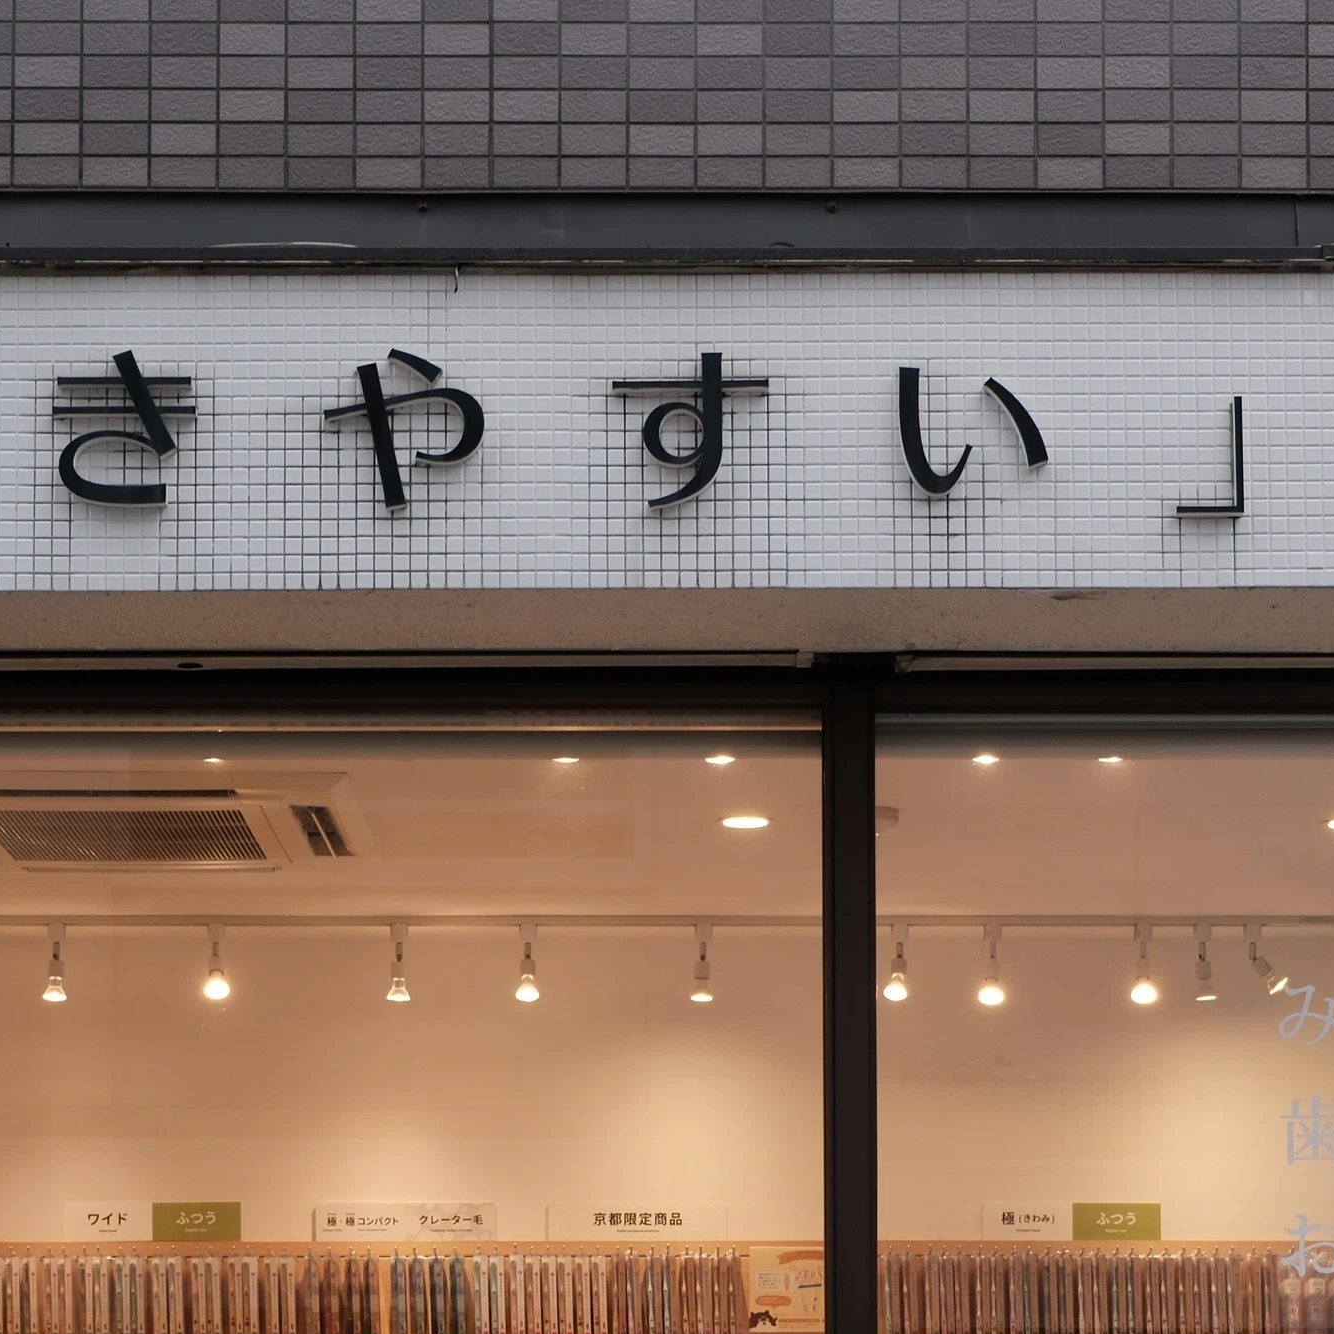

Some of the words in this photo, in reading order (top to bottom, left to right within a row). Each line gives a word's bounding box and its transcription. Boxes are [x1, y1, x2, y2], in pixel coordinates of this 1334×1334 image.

[87, 1212, 128, 1226] ワイド
[175, 1210, 217, 1226] ふつう
[419, 1213, 484, 1226] クレーター毛
[593, 1211, 684, 1226] 京都限定商品
[1000, 1211, 1055, 1226] 極（きわみ）
[1095, 1212, 1137, 1226] ふつう
